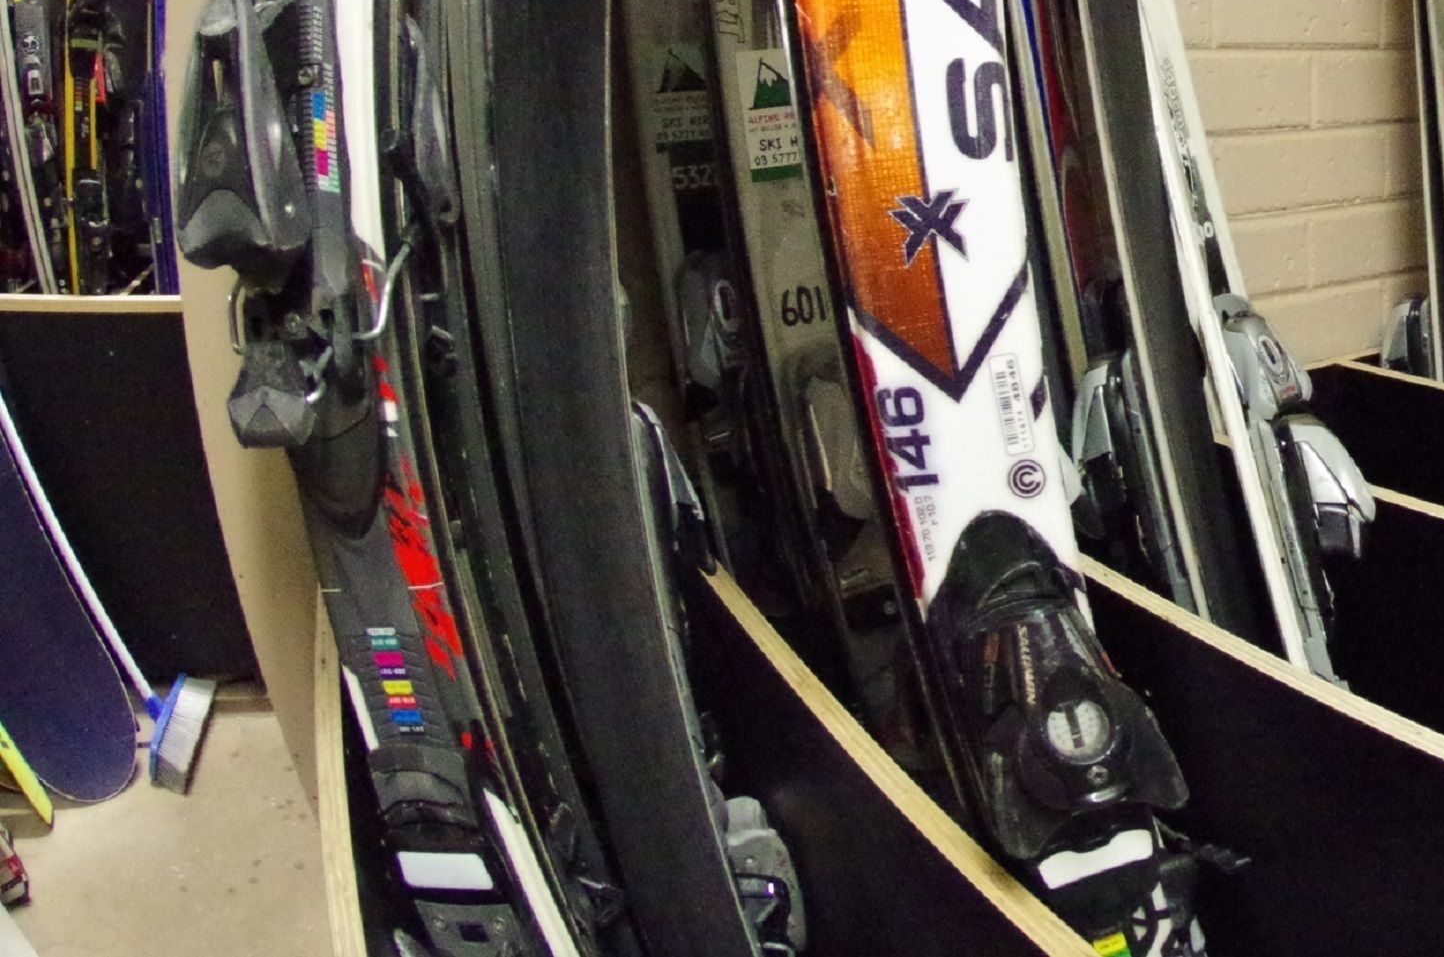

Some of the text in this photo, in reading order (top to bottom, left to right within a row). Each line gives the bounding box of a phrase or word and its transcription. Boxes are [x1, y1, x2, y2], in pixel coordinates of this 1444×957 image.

[753, 156, 768, 166] 03
[759, 137, 782, 151] SKI
[780, 285, 827, 327] 601
[1006, 359, 1021, 402] 4846
[876, 385, 940, 493] 146
